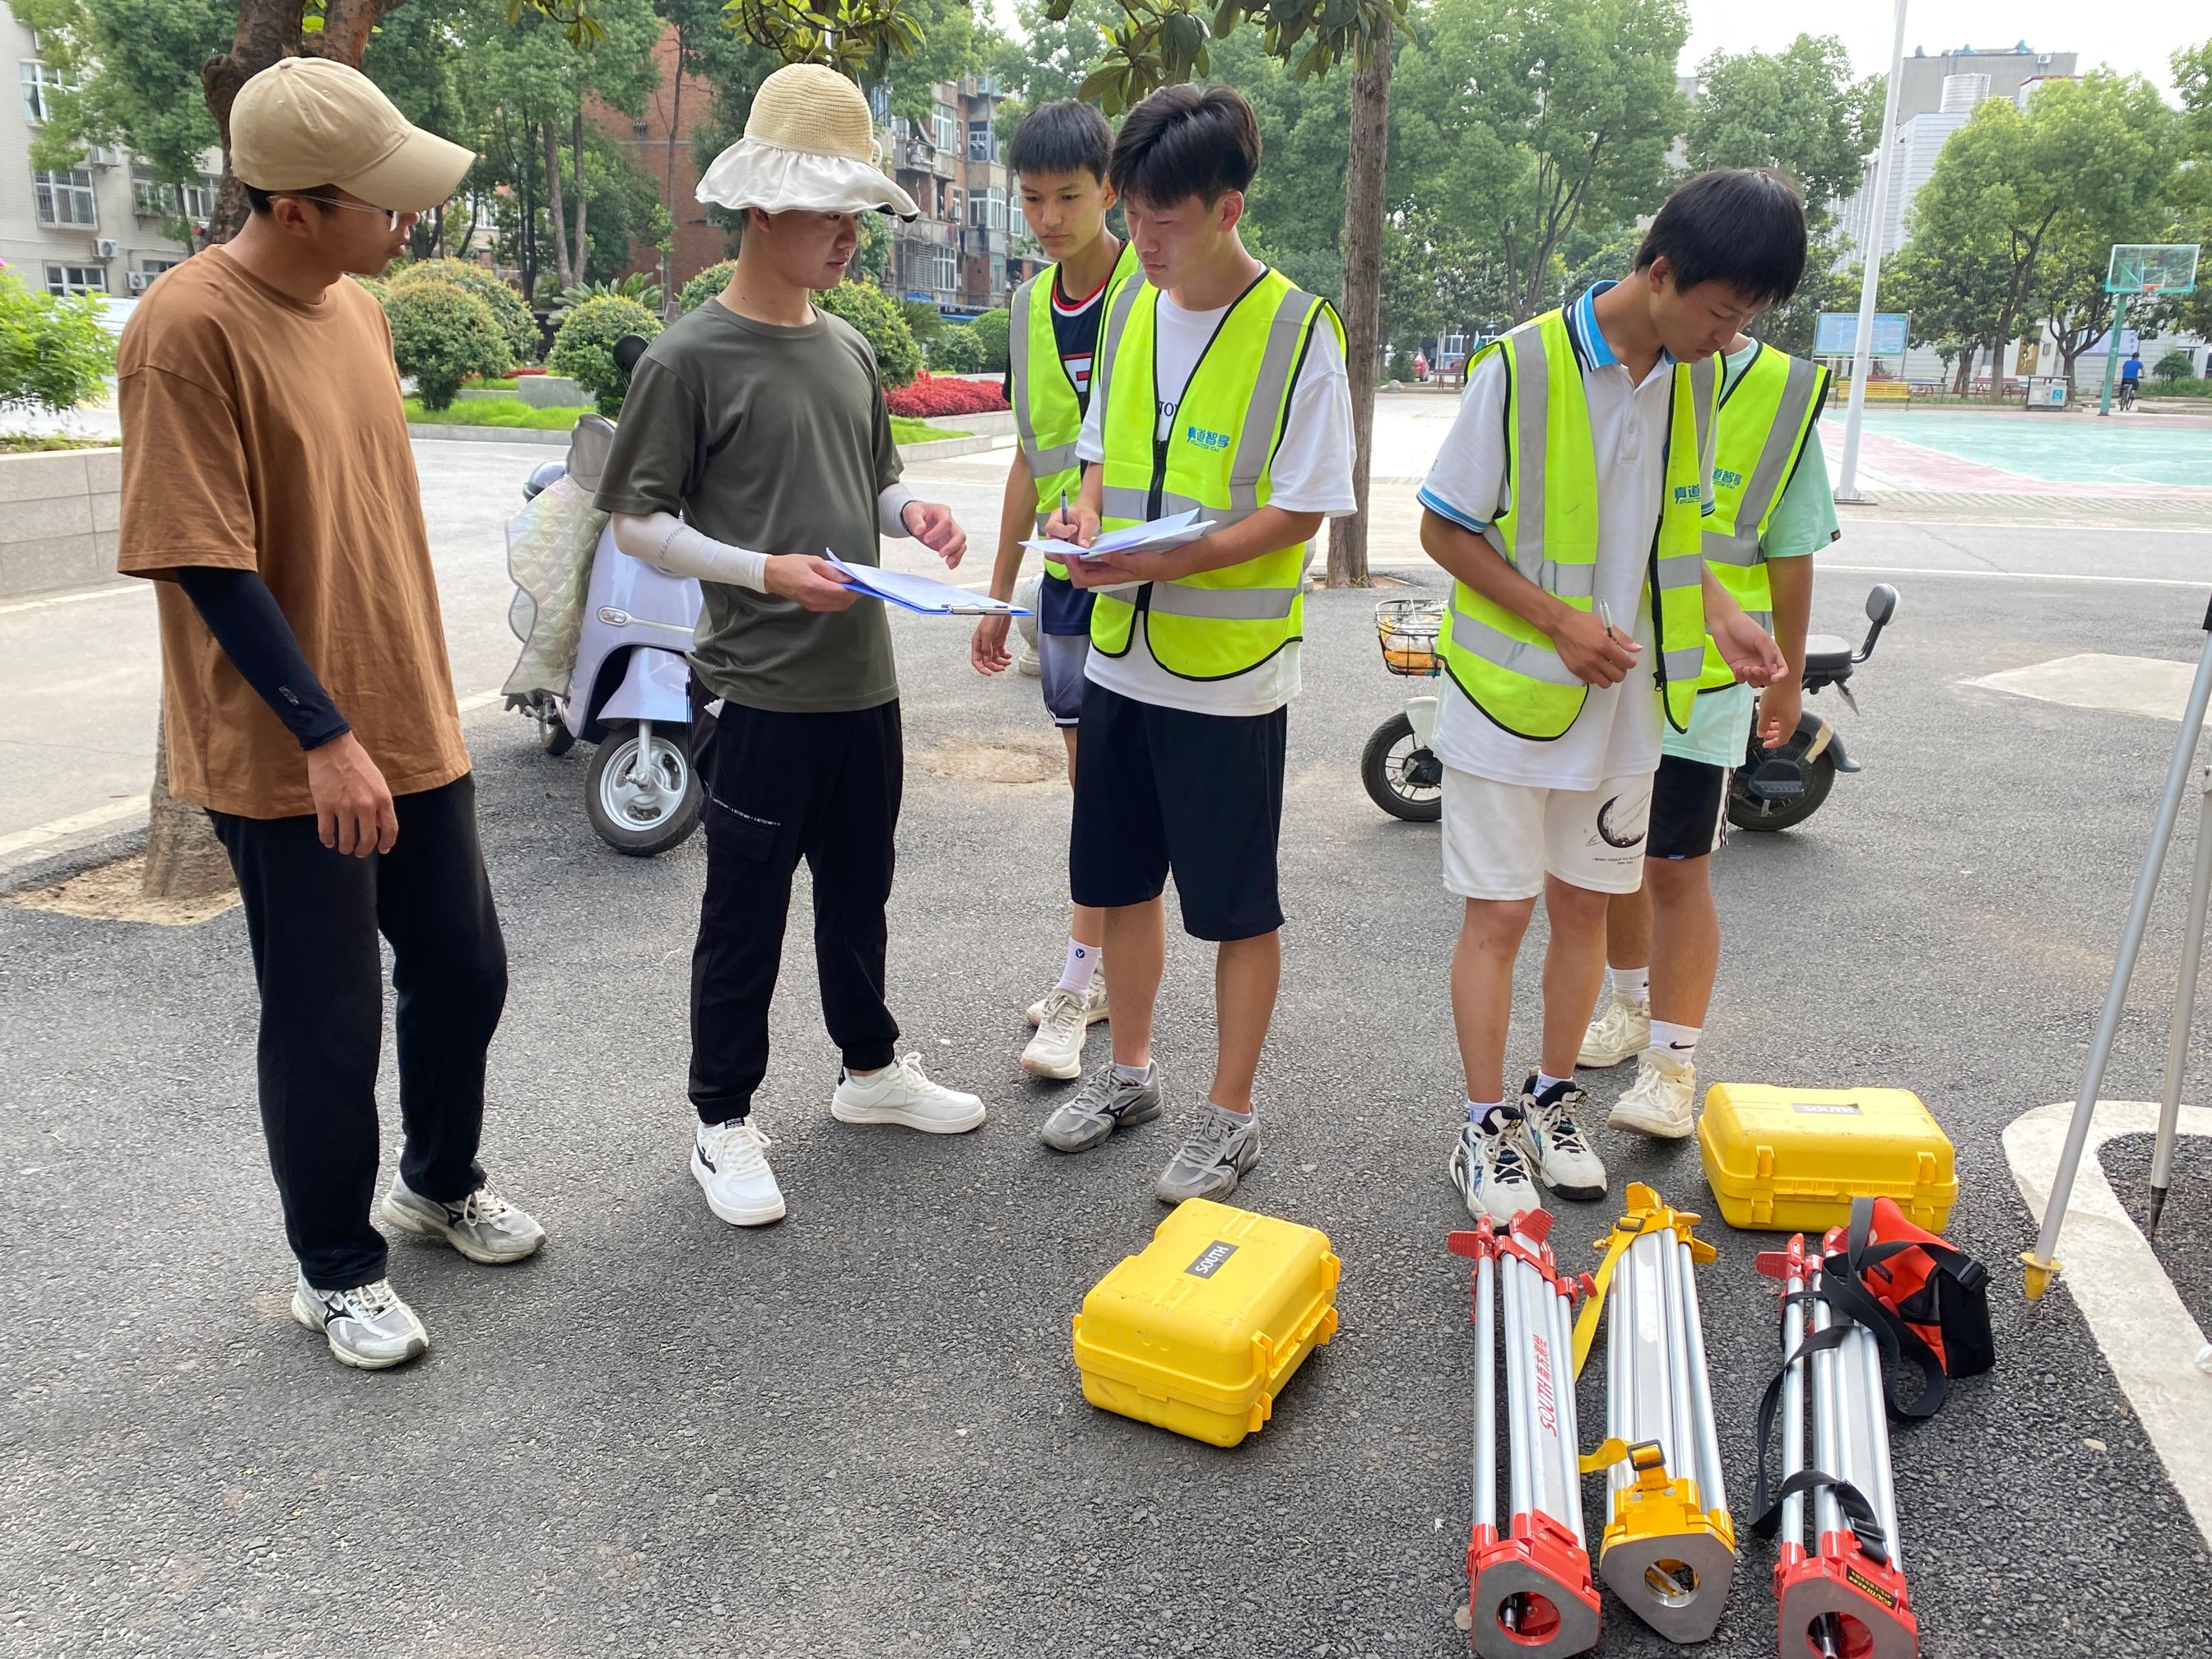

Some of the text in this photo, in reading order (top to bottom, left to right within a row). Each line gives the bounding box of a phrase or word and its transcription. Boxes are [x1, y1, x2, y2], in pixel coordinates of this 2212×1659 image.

[1801, 1105, 1854, 1113] SOUTH
[1195, 1245, 1229, 1274] SOUTH
[1536, 1376, 1558, 1438] SOUTH
